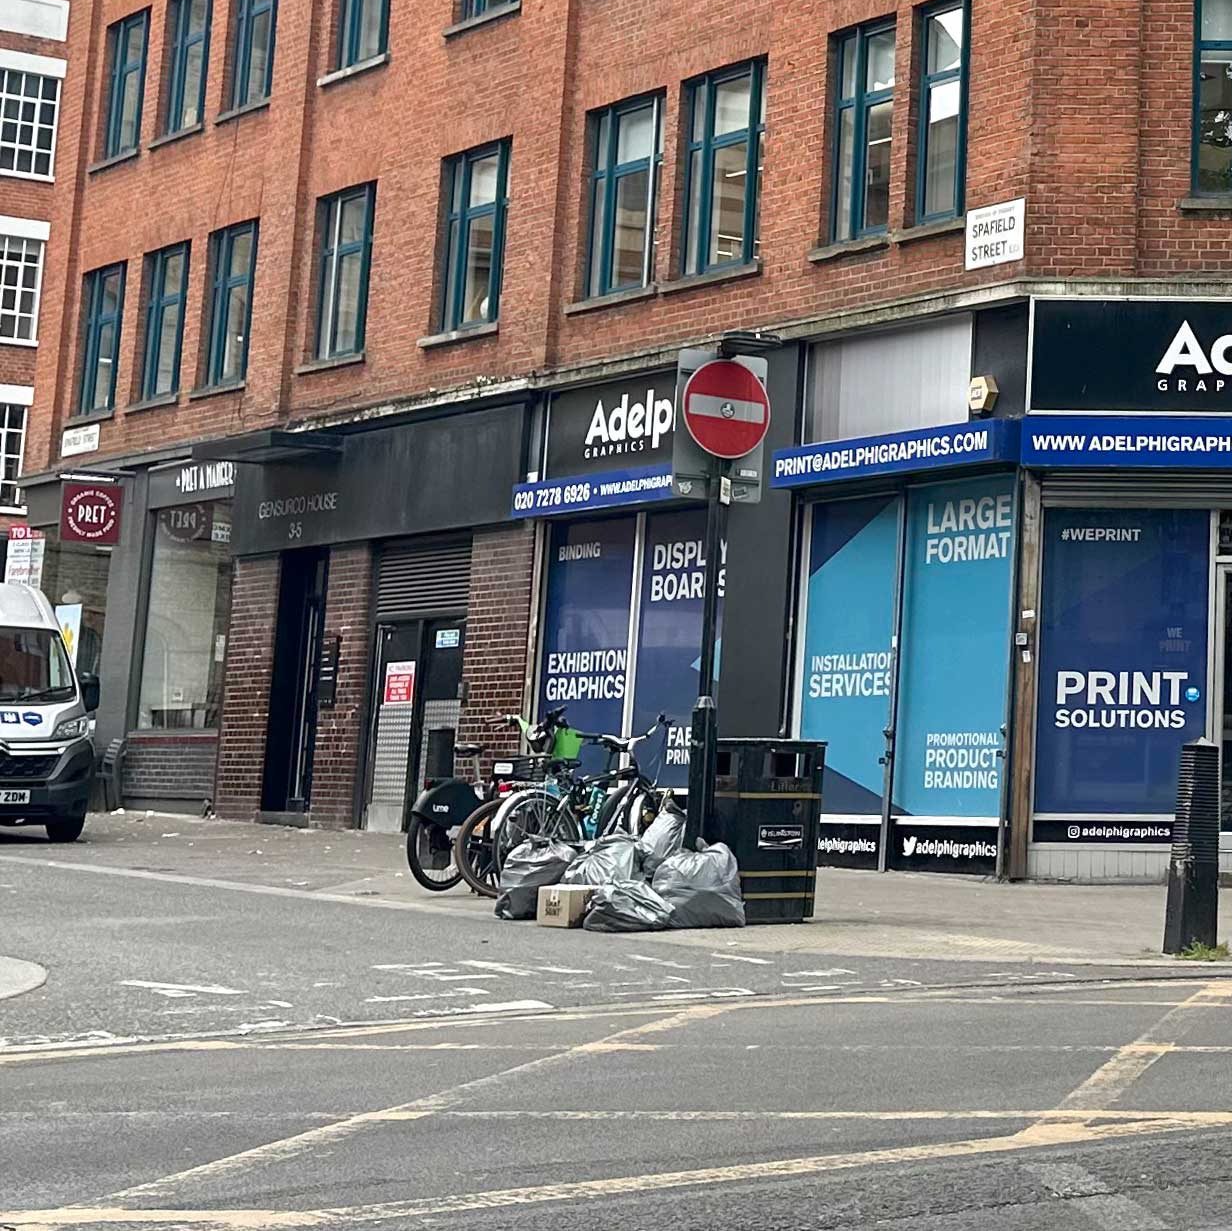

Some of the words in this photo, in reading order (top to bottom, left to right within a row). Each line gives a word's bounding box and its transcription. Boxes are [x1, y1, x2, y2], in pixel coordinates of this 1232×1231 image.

[972, 216, 1016, 239] SPAFIELD
[971, 240, 1008, 262] STREET
[584, 440, 645, 459] GRAPHICS
[775, 430, 988, 478] PRINT@ADELPHIGRAPHICS.COM
[181, 469, 197, 493] PRET
[199, 469, 204, 489] A
[206, 462, 234, 488] MANGER
[514, 491, 534, 511] 020
[536, 487, 561, 507] 7278
[563, 483, 591, 503] 6926
[78, 504, 107, 524] PRET
[927, 494, 1012, 535] LARGE
[12, 528, 25, 538] TO
[1061, 528, 1141, 542] #WEPRINT
[558, 542, 601, 561] BINDING
[653, 538, 728, 571] DISPLY
[925, 532, 1011, 564] FORMAT
[651, 568, 726, 602] BOARS
[548, 649, 627, 674] EXHIBITION
[546, 674, 626, 701] GRAPHICS
[1056, 671, 1188, 706] PRINT
[1055, 709, 1186, 729] SOLUTIONS
[926, 732, 999, 747] PROMOTIONAL
[925, 748, 998, 768] PRODUCT
[924, 770, 998, 789] BRANDING
[1082, 826, 1171, 838] adelphigraphics
[916, 839, 997, 859] adelphigraphics
